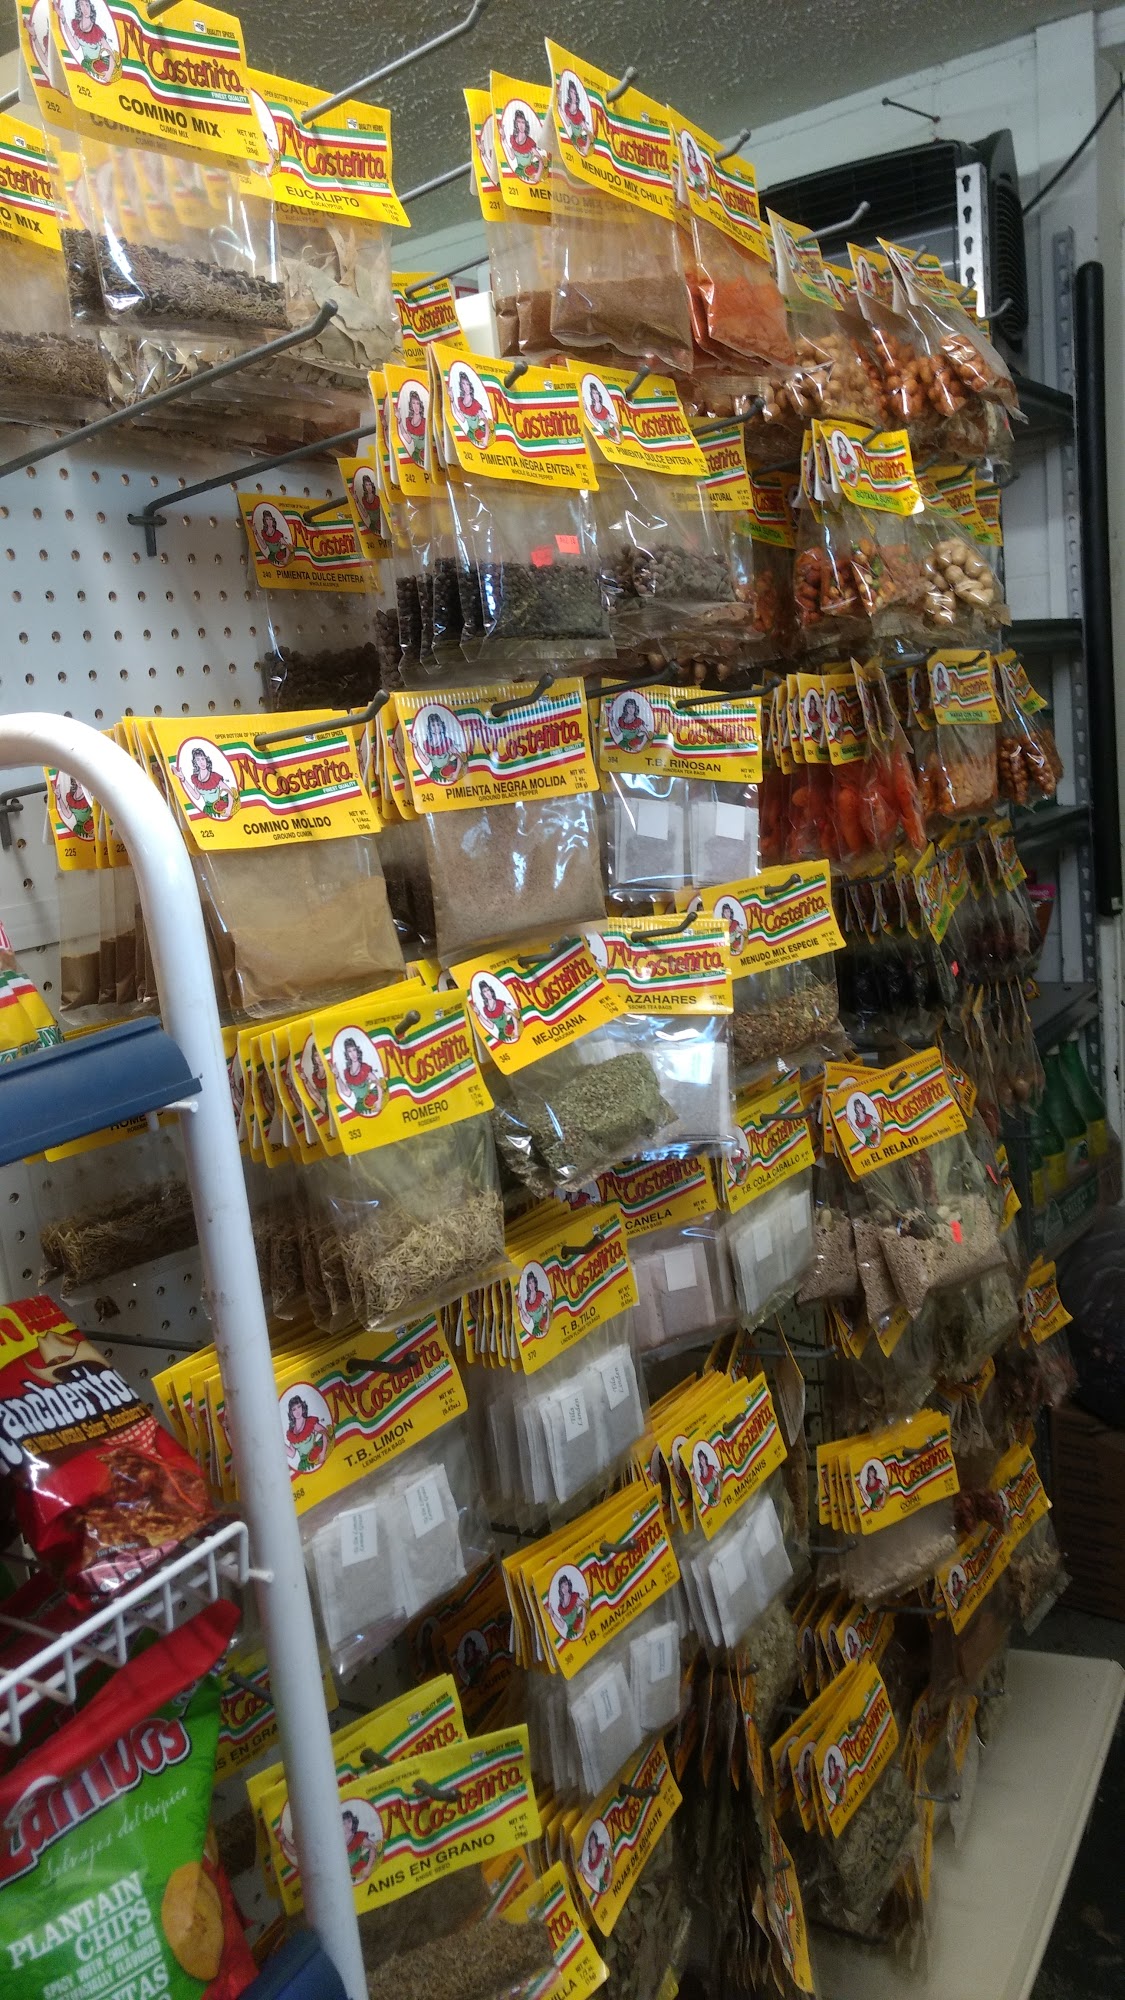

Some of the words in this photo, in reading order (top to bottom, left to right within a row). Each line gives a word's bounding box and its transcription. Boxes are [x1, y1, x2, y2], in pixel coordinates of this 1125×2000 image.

[76, 85, 92, 98] 252
[45, 100, 62, 114] 252
[118, 94, 188, 129] COMINO
[191, 116, 222, 138] MIX
[159, 124, 175, 136] CUMIN
[176, 128, 189, 139] MIX
[581, 158, 622, 187] MENUDO
[624, 178, 639, 195] MIX
[640, 187, 664, 207] CHILI
[286, 185, 360, 208] EUCALIPTO
[489, 200, 501, 210] 231
[14, 212, 44, 235] MIX
[463, 451, 474, 462] 242
[480, 452, 519, 468] PIMIENTA
[519, 457, 545, 473] NEGRA
[547, 462, 577, 477] ENTERA
[615, 446, 644, 461] PIMIENTA
[645, 452, 666, 464] DULCE
[667, 456, 693, 466] ENTERA
[404, 473, 416, 483] 242
[309, 533, 357, 556] Costeñi
[276, 569, 311, 581] PIMIENTA
[311, 571, 336, 582] DULCE
[337, 573, 364, 583] ENTERA
[215, 732, 226, 740] OPEN
[226, 732, 243, 740] BOTTOM
[317, 732, 331, 741] QUALITY
[331, 730, 344, 738] SPICES
[645, 757, 668, 767] T.B.
[669, 757, 722, 773] RIÑOSAN
[262, 758, 354, 797] Costeñita
[323, 786, 338, 794] FINEST
[338, 781, 357, 792] QUALITY
[445, 785, 490, 800] PIMIENTA
[493, 780, 528, 795] NEGRA
[529, 774, 567, 791] MOLIDA
[421, 793, 435, 802] 243
[518, 790, 539, 798] PEPPER
[200, 829, 215, 839] 225
[243, 819, 289, 835] COMINO
[291, 816, 332, 830] MOLIDO
[273, 832, 296, 841] GROUND
[296, 831, 313, 839] CUMIN
[65, 848, 77, 857] 225
[740, 951, 771, 966] MENUDO
[772, 946, 787, 958] MIX
[788, 937, 819, 953] ESPECIE
[625, 994, 697, 1005] AZAHARES
[531, 1014, 587, 1046] MEJORANA
[499, 1054, 511, 1064] 345
[402, 1099, 449, 1124] ROMERO
[348, 1129, 362, 1141] 353
[870, 1152, 883, 1163] EL
[883, 1135, 920, 1157] RELAJO
[753, 1170, 772, 1190] COLA
[772, 1153, 801, 1177] CABALLO
[624, 1208, 673, 1230] CANELA
[579, 1305, 596, 1324] TILO
[415, 1375, 430, 1388] FINEST
[430, 1361, 448, 1377] QUALITY
[344, 1452, 372, 1467] T.B.
[372, 1418, 414, 1450] LIMON
[362, 1454, 382, 1468] LEMON
[382, 1446, 392, 1456] TEA
[391, 1438, 406, 1451] BAGS
[734, 1459, 767, 1493] MANZANIS
[581, 1629, 600, 1646] T.B.
[600, 1578, 658, 1631] MANZANILLA
[230, 1743, 249, 1761] EN
[252, 1722, 279, 1746] GRA
[611, 1868, 631, 1898] HOJAS
[630, 1853, 639, 1869] DE
[638, 1807, 663, 1854] AGUACATE
[367, 1871, 406, 1896] ANIS
[410, 1859, 431, 1876] EN
[434, 1833, 495, 1864] GRANO
[6, 1870, 143, 1970] PLANTAIN
[75, 1897, 152, 1962] CHIPS
